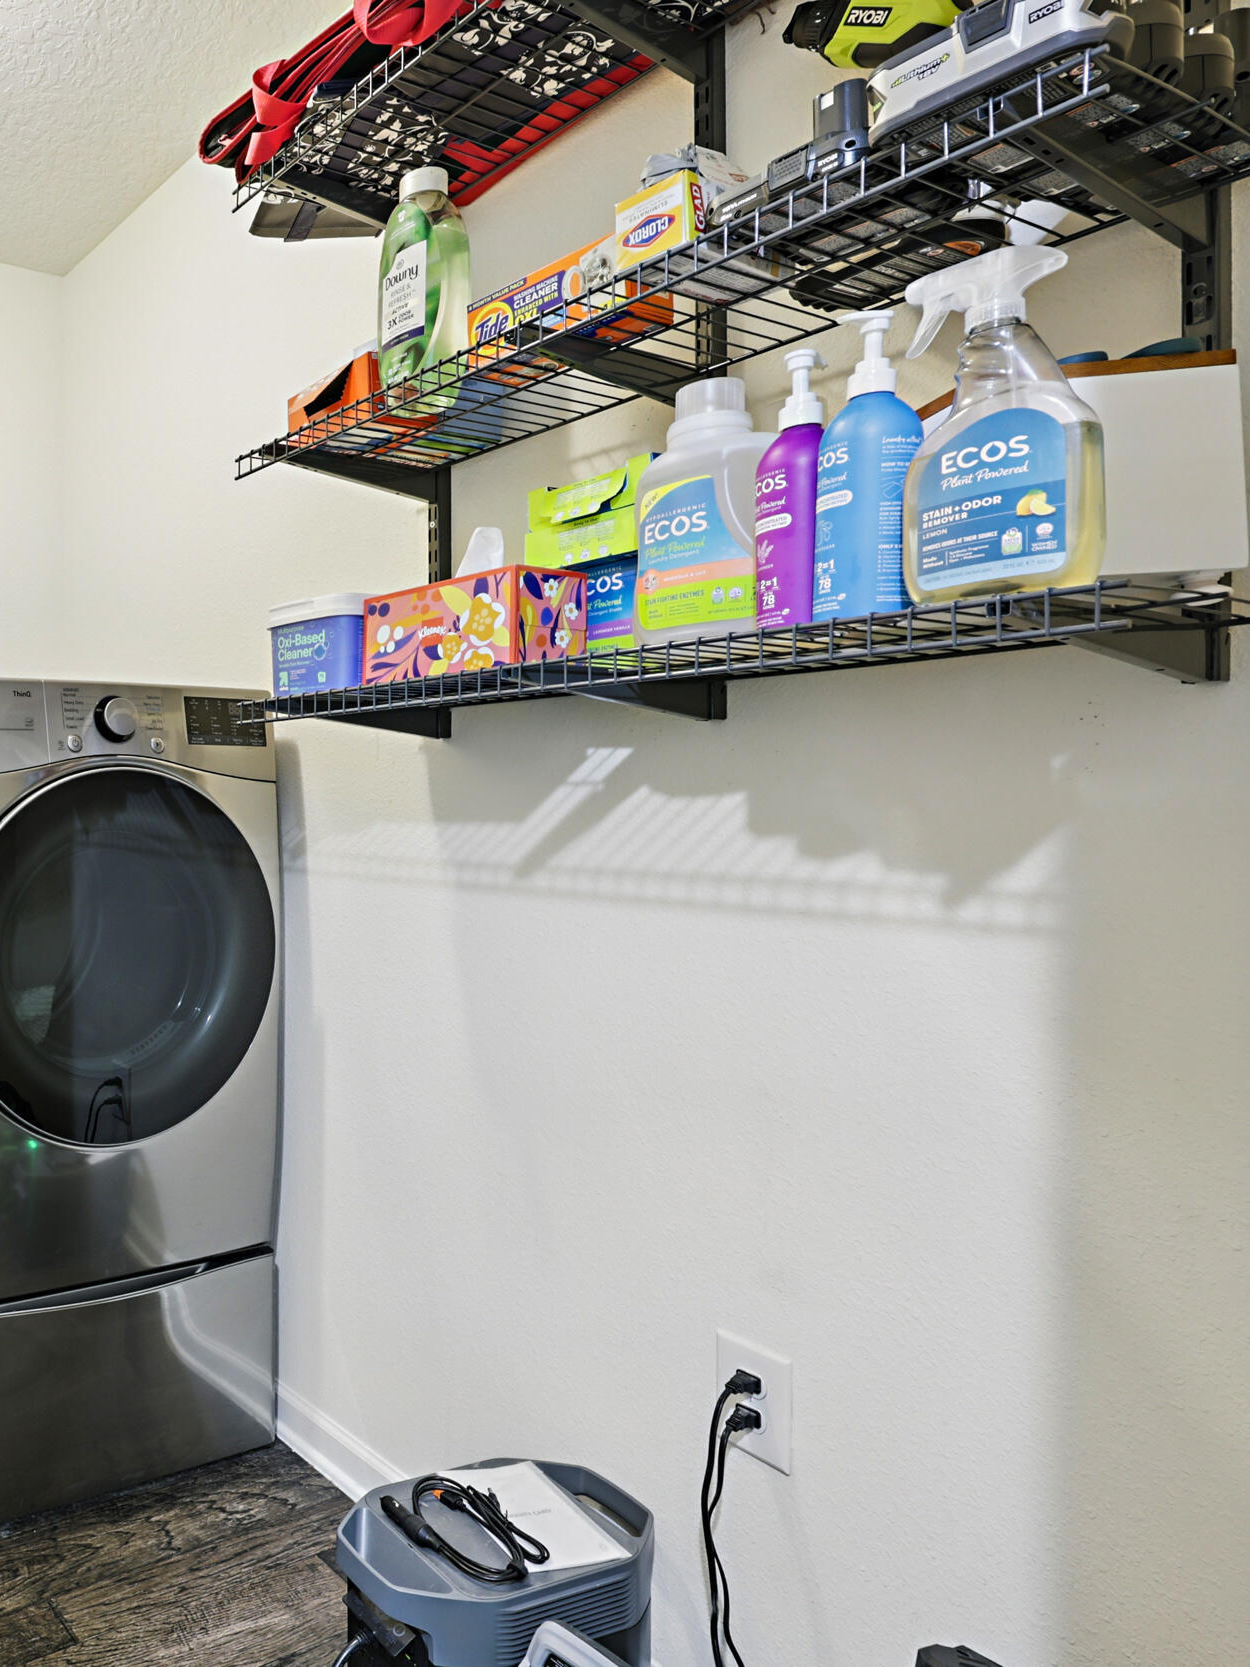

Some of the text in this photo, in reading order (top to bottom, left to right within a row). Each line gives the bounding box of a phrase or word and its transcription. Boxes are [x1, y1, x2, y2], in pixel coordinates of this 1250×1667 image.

[847, 9, 889, 24] RYOBI
[692, 184, 706, 230] GLAD
[628, 215, 669, 246] CLOROX
[385, 264, 419, 291] Downy
[513, 275, 559, 300] WASHING MACHINE
[472, 296, 492, 309] MONTH
[492, 286, 510, 300] VALUE
[510, 280, 525, 291] PACK
[513, 282, 558, 309] CLEANER
[514, 291, 559, 316] ENHANCED WITH
[387, 316, 398, 330] 3X
[475, 310, 510, 342] Tide
[817, 447, 849, 472] COS
[940, 434, 1031, 475] ECOS
[755, 474, 787, 497] COS
[941, 460, 1030, 491] Plant Powered
[922, 506, 953, 522] STAIN
[961, 495, 1002, 511] ODOR
[922, 512, 968, 529] REMOVER
[644, 511, 708, 545] ECOS
[922, 528, 948, 540] LEMON
[668, 535, 706, 553] Powered
[587, 572, 623, 596] COS
[818, 578, 832, 591] 78
[762, 594, 775, 606] 78
[277, 629, 326, 649] Oxi-Based
[277, 647, 314, 662] Cleaner
[12, 690, 33, 698] ThinQ
